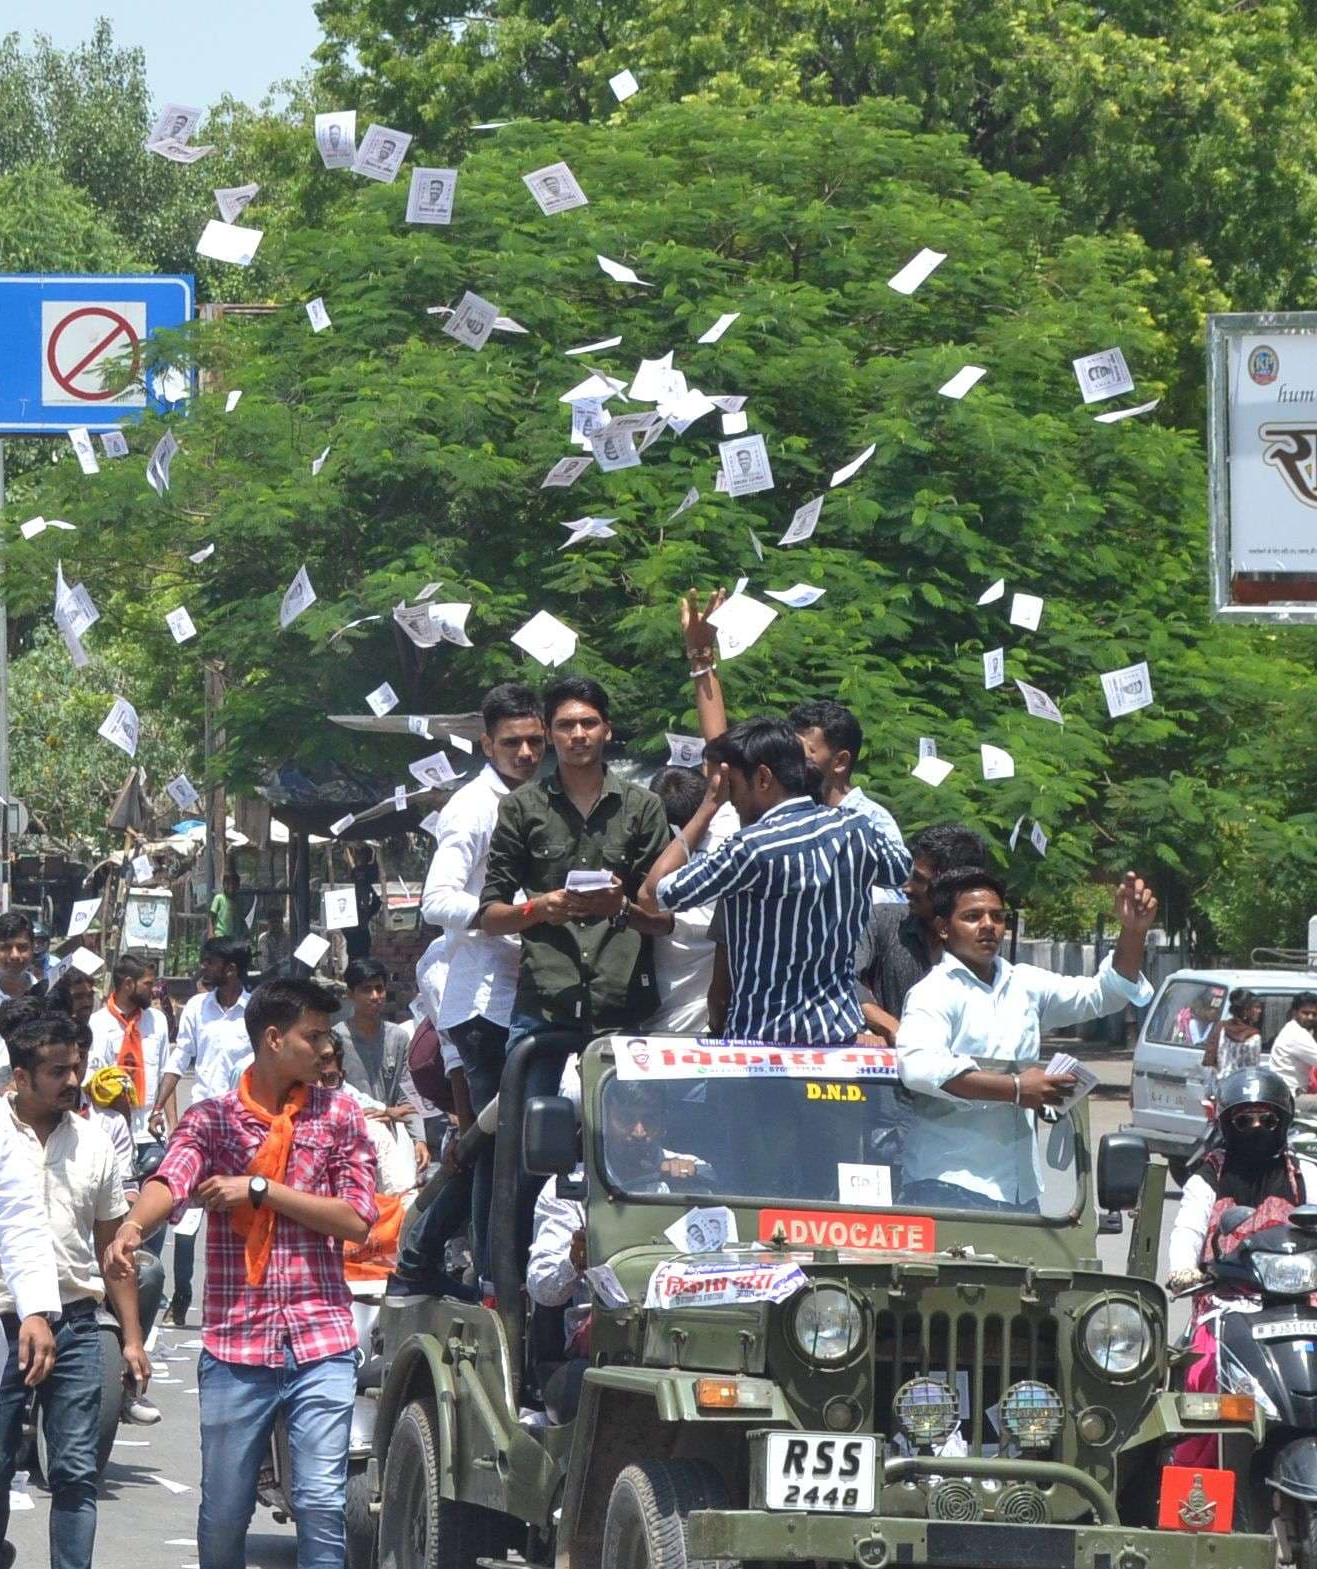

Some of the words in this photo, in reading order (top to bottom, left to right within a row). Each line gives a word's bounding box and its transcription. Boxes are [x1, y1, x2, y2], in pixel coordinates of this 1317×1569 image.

[807, 1083, 867, 1101] D.N.D.
[771, 1219, 924, 1249] ADVOCATE
[782, 1439, 863, 1480] RSS
[783, 1485, 859, 1510] 2448
